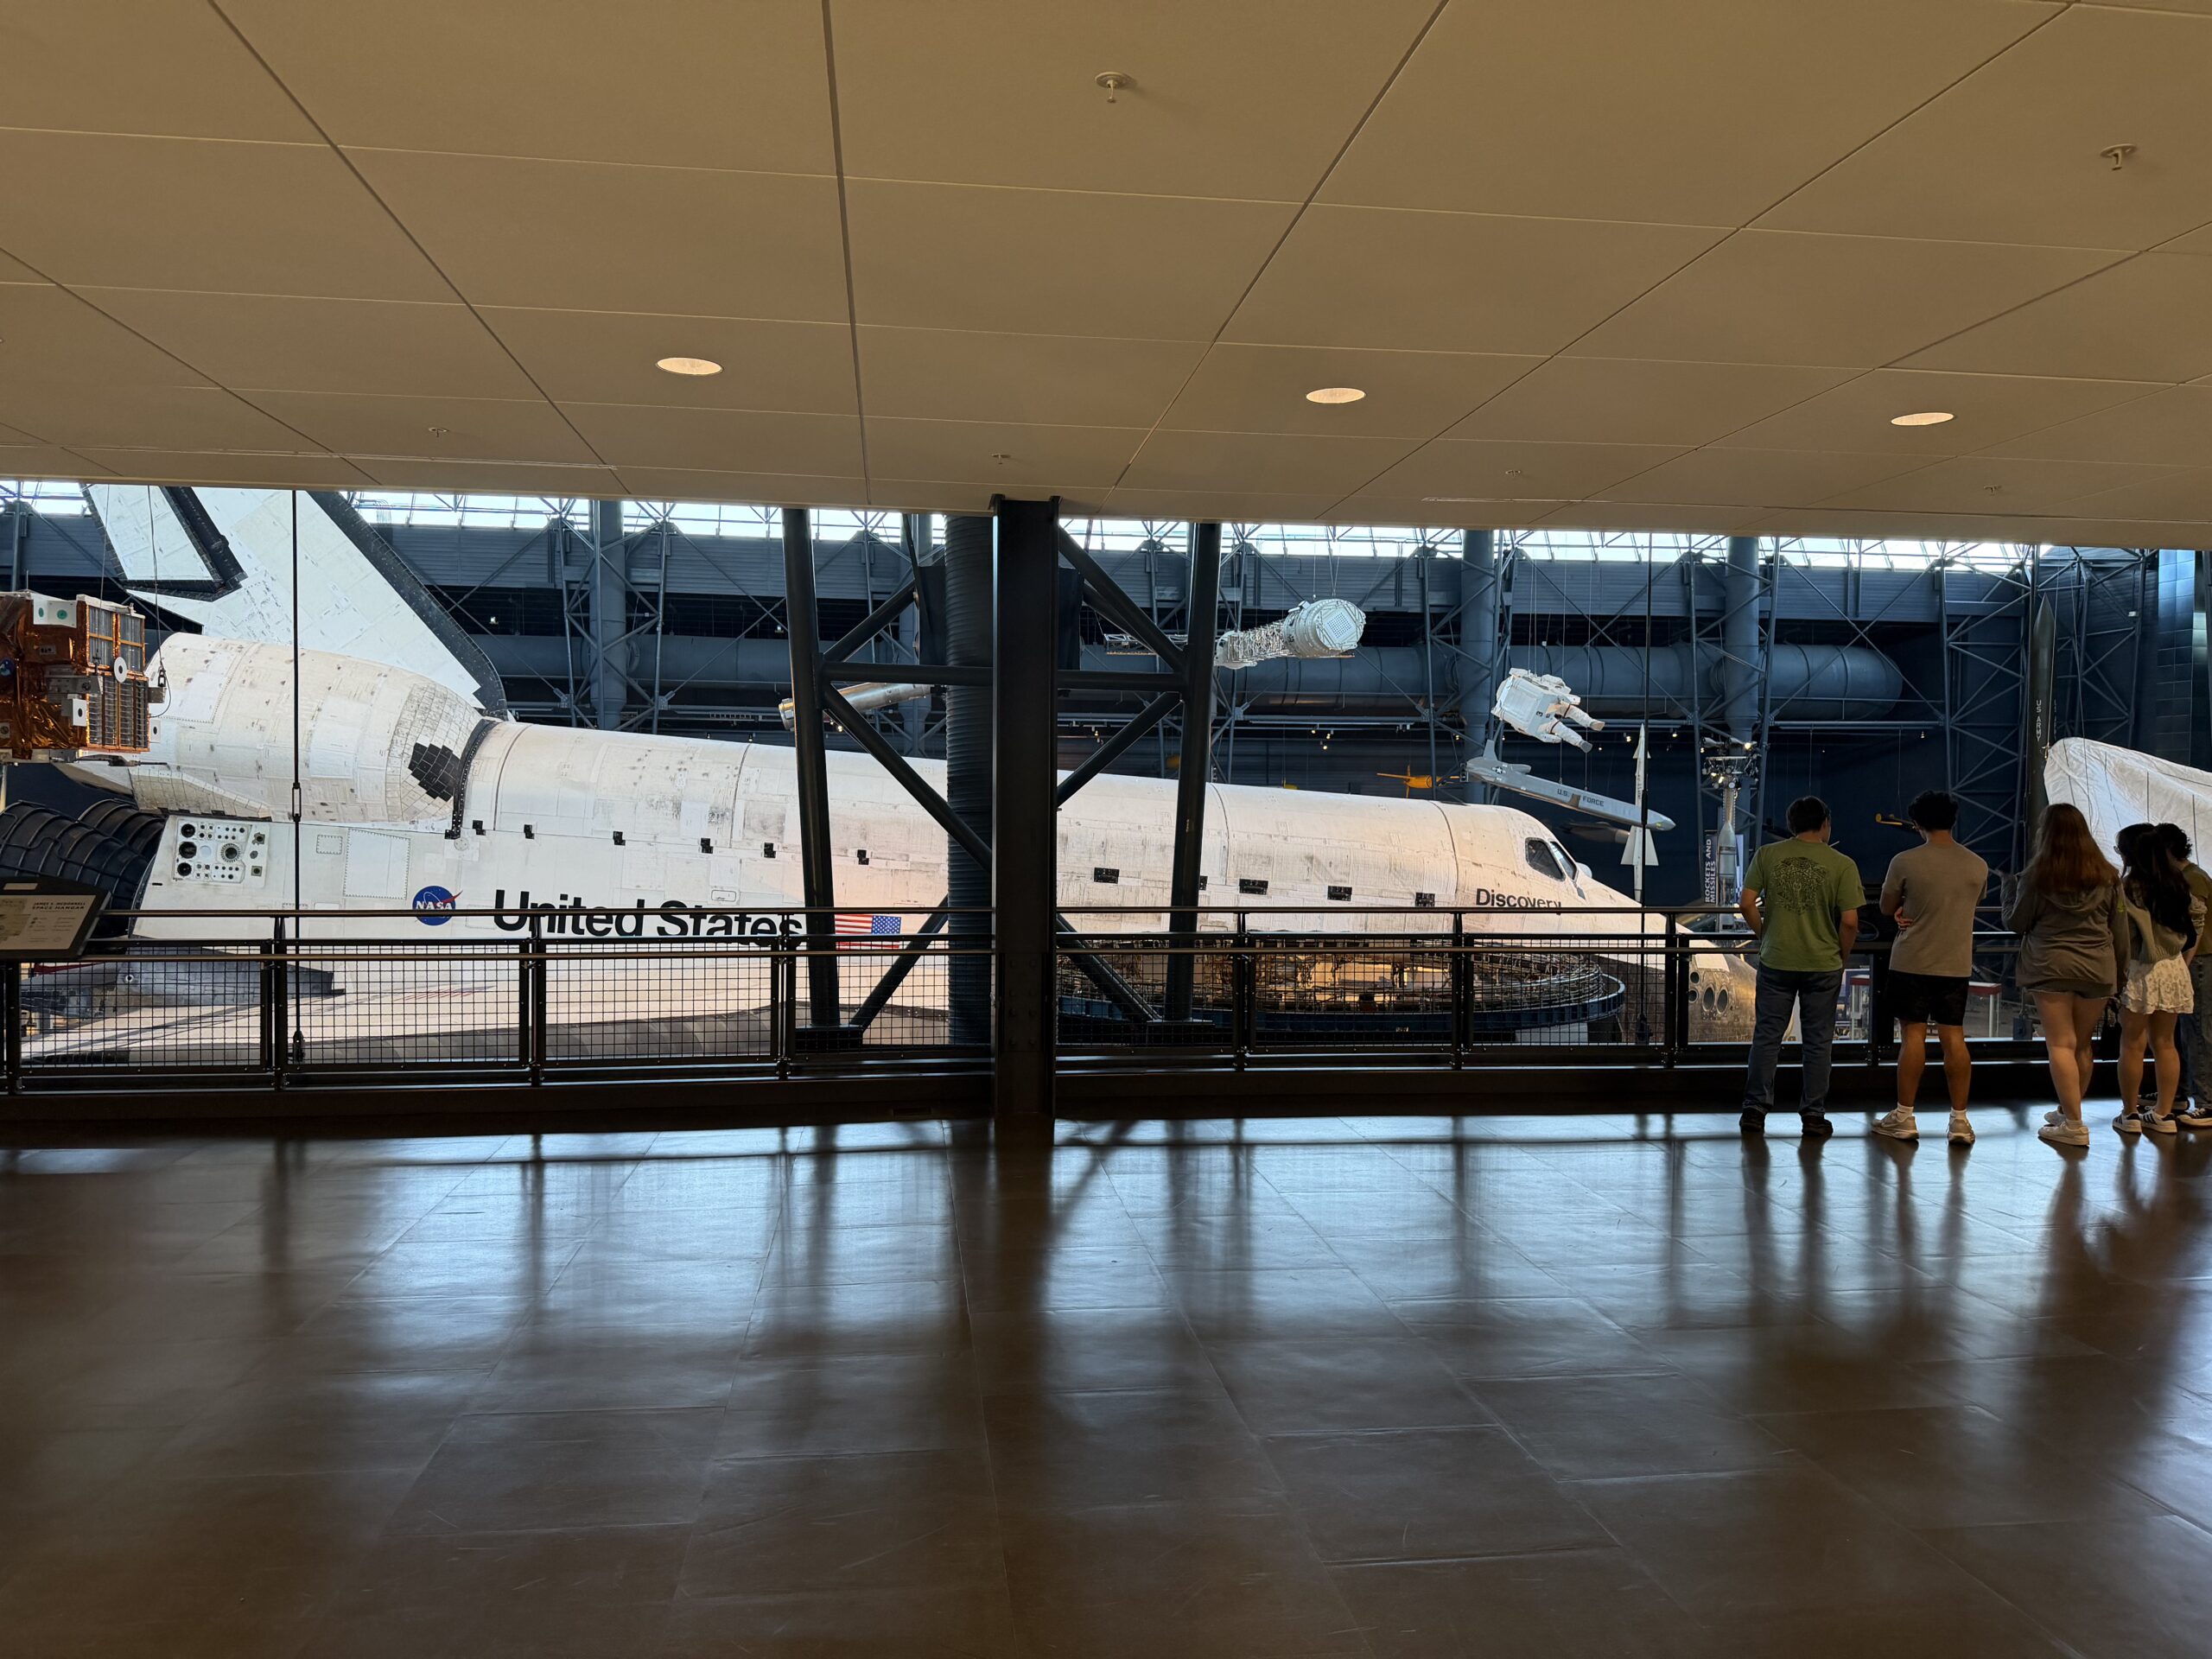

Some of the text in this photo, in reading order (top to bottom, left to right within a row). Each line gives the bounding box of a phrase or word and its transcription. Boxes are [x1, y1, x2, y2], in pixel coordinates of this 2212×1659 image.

[1582, 795, 1605, 807] FORCE
[416, 900, 453, 910] NASA
[1476, 887, 1562, 915] Discovery
[494, 889, 645, 937] United
